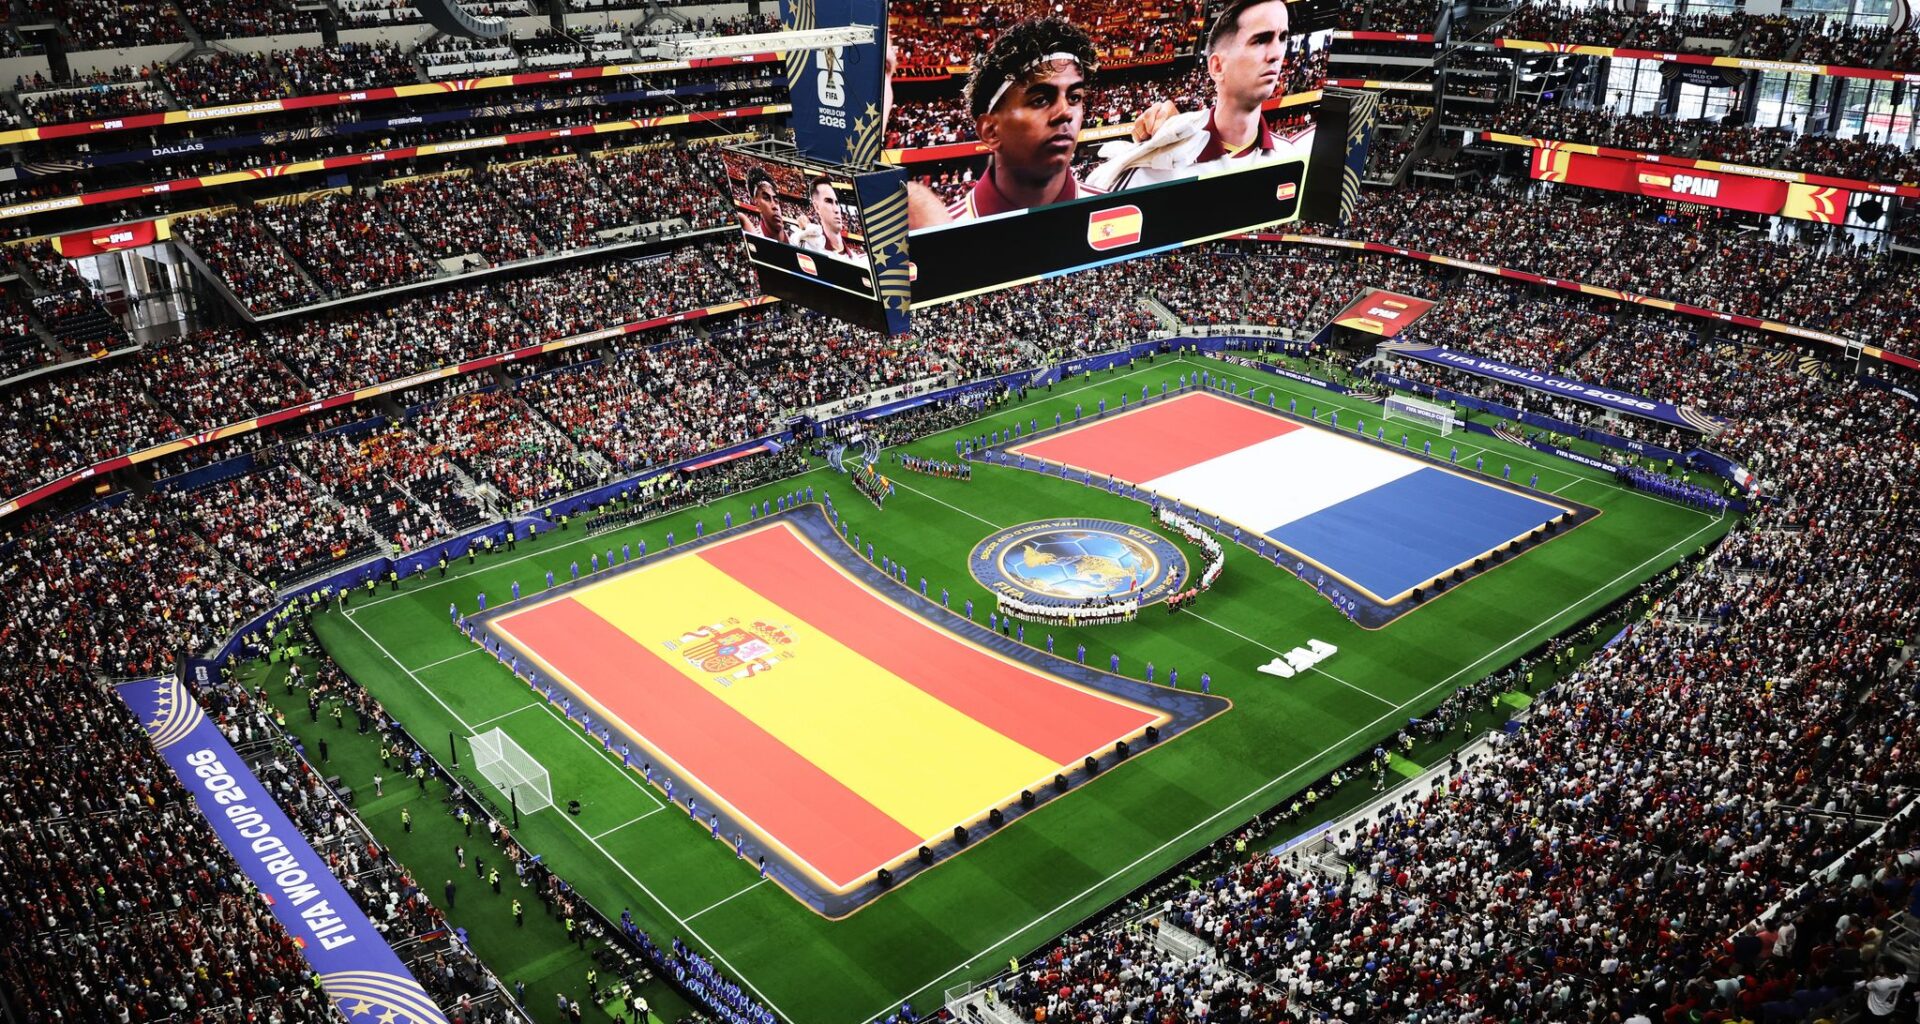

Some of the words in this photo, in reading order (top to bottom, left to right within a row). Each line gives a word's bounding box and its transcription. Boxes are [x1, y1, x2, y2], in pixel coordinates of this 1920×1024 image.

[825, 91, 838, 101] FIFA
[188, 110, 207, 119] FIFA
[207, 106, 236, 117] WORLD
[236, 105, 253, 114] CUP
[253, 102, 282, 112] 2026
[818, 107, 836, 117] WORLD
[835, 109, 846, 117] CUP
[818, 115, 847, 129] 2026
[152, 143, 205, 157] DALLAS
[1671, 174, 1720, 198] SPAIN
[0, 205, 32, 216] WORLD
[32, 202, 50, 212] CUP
[109, 231, 134, 244] SPAIN
[1388, 376, 1401, 385] FIFA
[1437, 351, 1476, 368] FIFA
[1478, 361, 1544, 383] WORLD
[1544, 376, 1585, 393] CUP
[1583, 387, 1658, 412] 2026
[1417, 409, 1436, 419] WORLD
[1628, 441, 1643, 451] FIFA
[1555, 449, 1568, 458] FIFA
[1568, 453, 1590, 465] WORLD
[1590, 459, 1602, 468] CUP
[1128, 529, 1158, 545] FIFA
[993, 581, 1025, 599] FIFA
[185, 748, 248, 805] 2026
[225, 804, 272, 839] CUP
[251, 835, 321, 907] WORLD
[300, 899, 357, 951] FIFA
